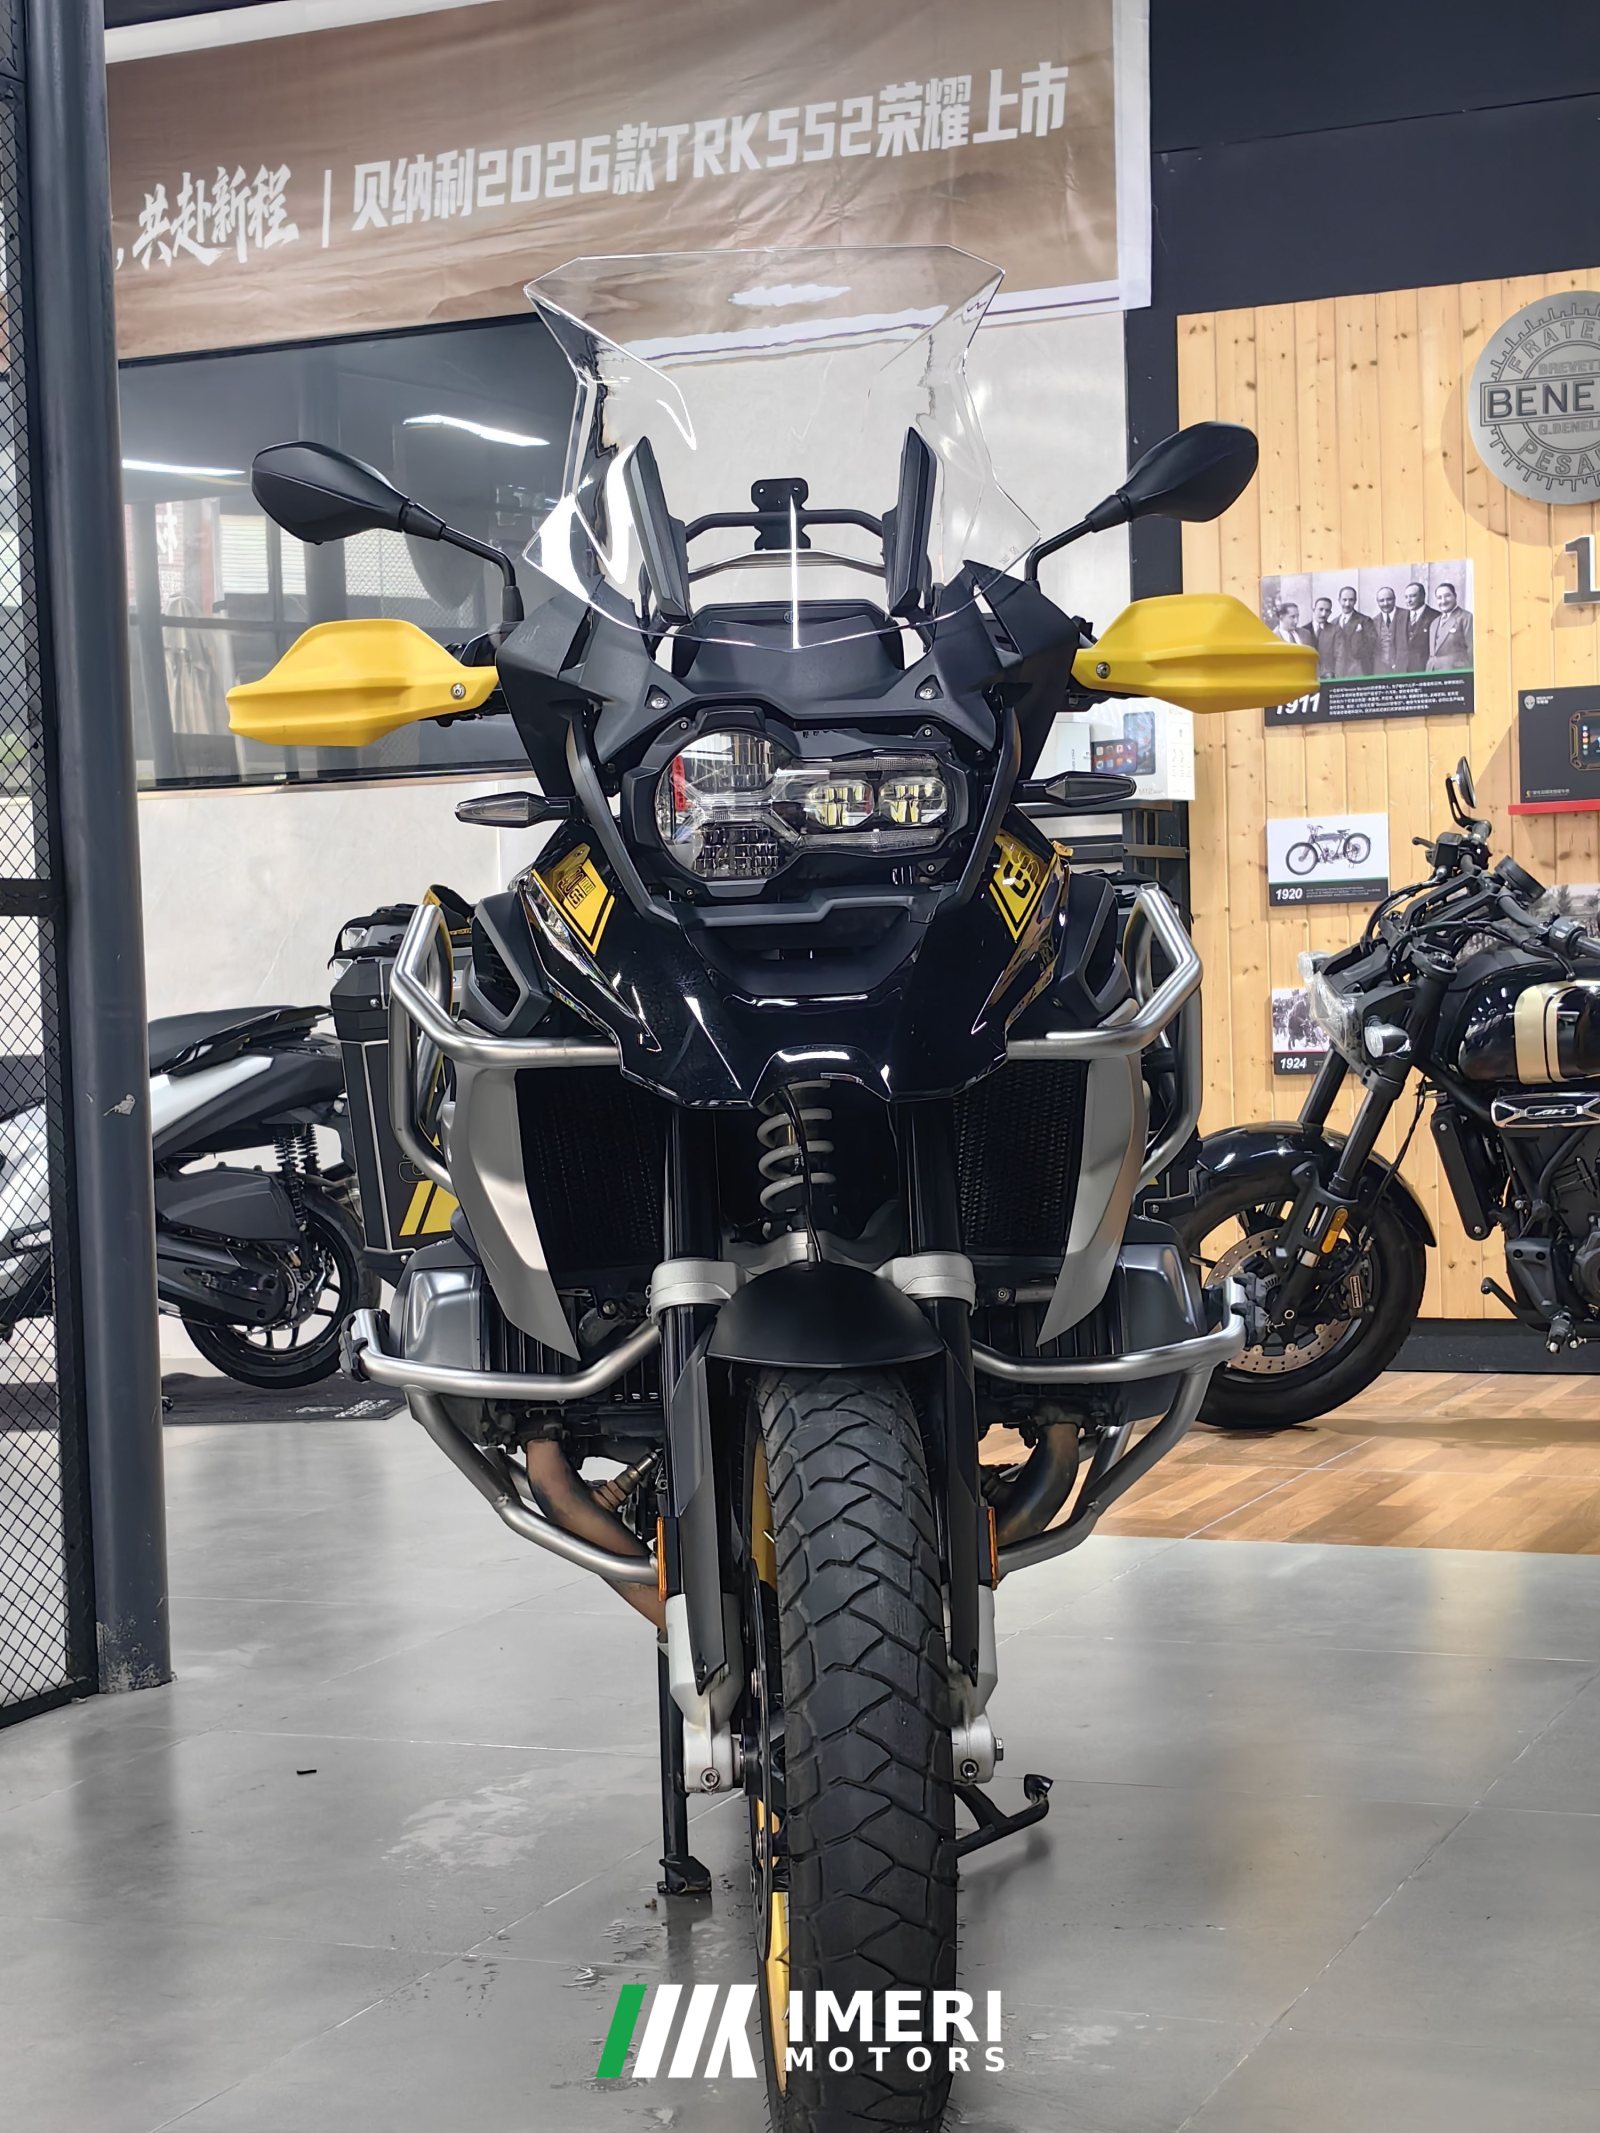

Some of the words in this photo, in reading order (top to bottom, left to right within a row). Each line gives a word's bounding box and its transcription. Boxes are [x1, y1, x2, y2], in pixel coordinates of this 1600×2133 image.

[1517, 439, 1600, 475] PESA
[1275, 888, 1303, 900] 1920
[1280, 1057, 1307, 1069] 1924
